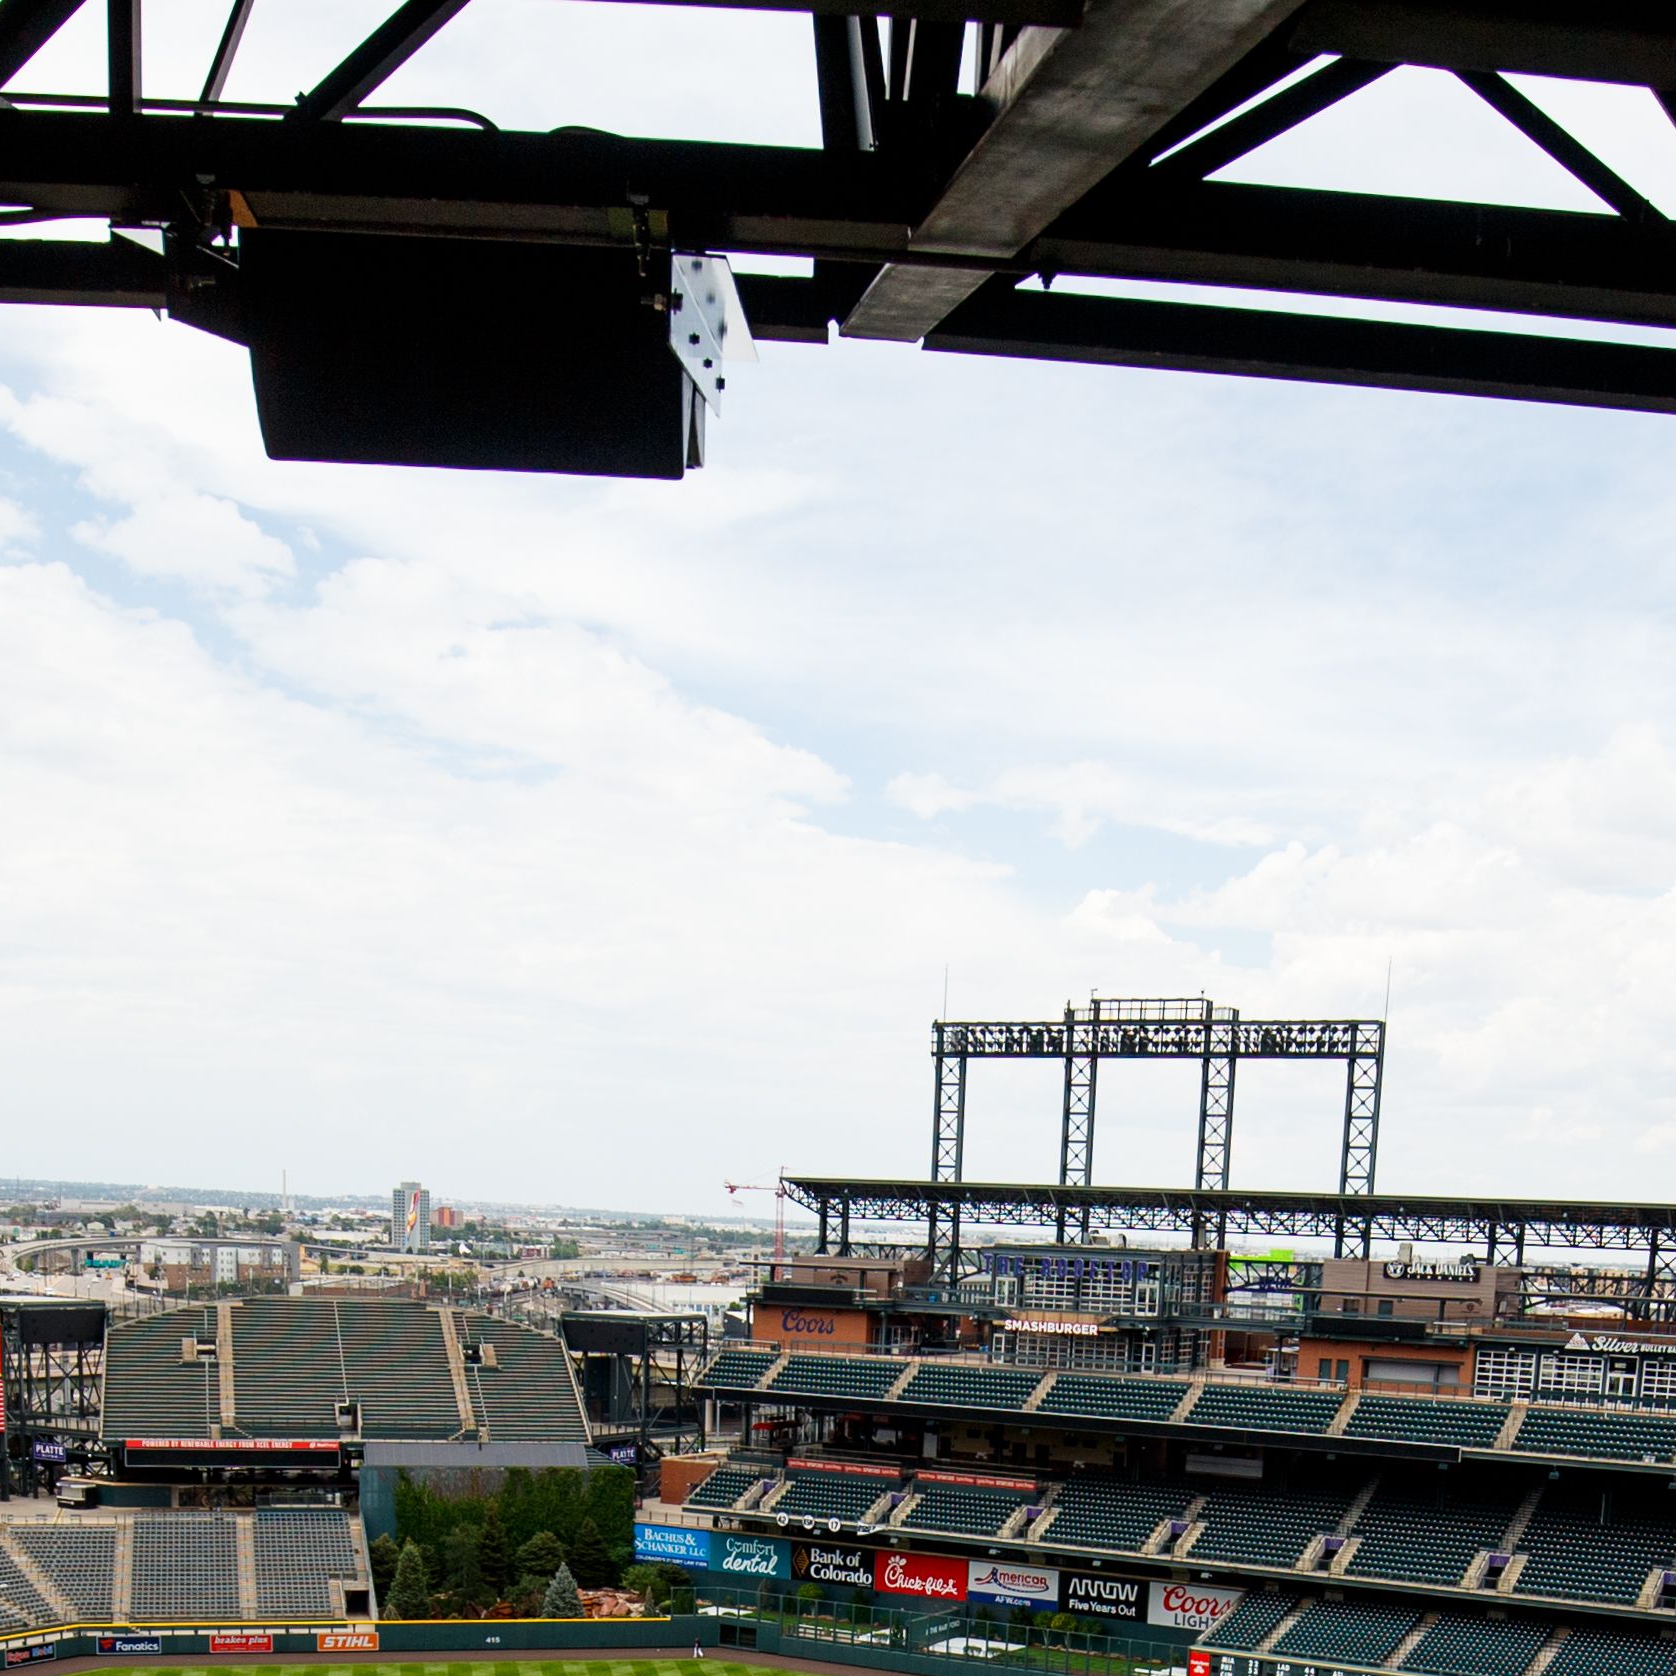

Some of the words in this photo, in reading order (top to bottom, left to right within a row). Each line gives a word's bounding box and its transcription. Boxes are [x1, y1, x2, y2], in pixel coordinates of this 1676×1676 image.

[984, 1253, 1024, 1276] THE
[1040, 1257, 1150, 1281] ROOFTOP
[1407, 1262, 1433, 1274] JACK
[1435, 1263, 1475, 1277] DANIEL'S
[781, 1307, 835, 1334] Coors
[1004, 1319, 1098, 1335] SMASHBURGER
[1592, 1336, 1639, 1354] Silver
[35, 1444, 64, 1456] PLATTE
[141, 1440, 169, 1448] POWERED
[171, 1440, 179, 1448] BY
[215, 1440, 237, 1449] ENERGY
[238, 1441, 254, 1449] FROM
[271, 1441, 292, 1449] ENERGY
[644, 1528, 685, 1543] BACHUS
[686, 1533, 696, 1546] &
[635, 1538, 686, 1555] SCHANKER
[689, 1547, 706, 1557] LLC
[726, 1537, 775, 1556] Comfort
[722, 1550, 779, 1576] dental
[810, 1548, 844, 1566] Bank
[846, 1552, 862, 1568] of
[810, 1563, 873, 1585] Colorado
[884, 1555, 958, 1595] Chick-fil-A
[1068, 1600, 1089, 1611] Five
[1089, 1602, 1117, 1614] Years
[1118, 1605, 1136, 1617] Out
[1163, 1585, 1231, 1617] Coors
[115, 1641, 159, 1651] Fanatics
[213, 1635, 246, 1645] brakes
[248, 1635, 269, 1645] plus
[323, 1636, 374, 1648] STIHL
[485, 1636, 501, 1644] 415
[1277, 1663, 1291, 1672] LAD
